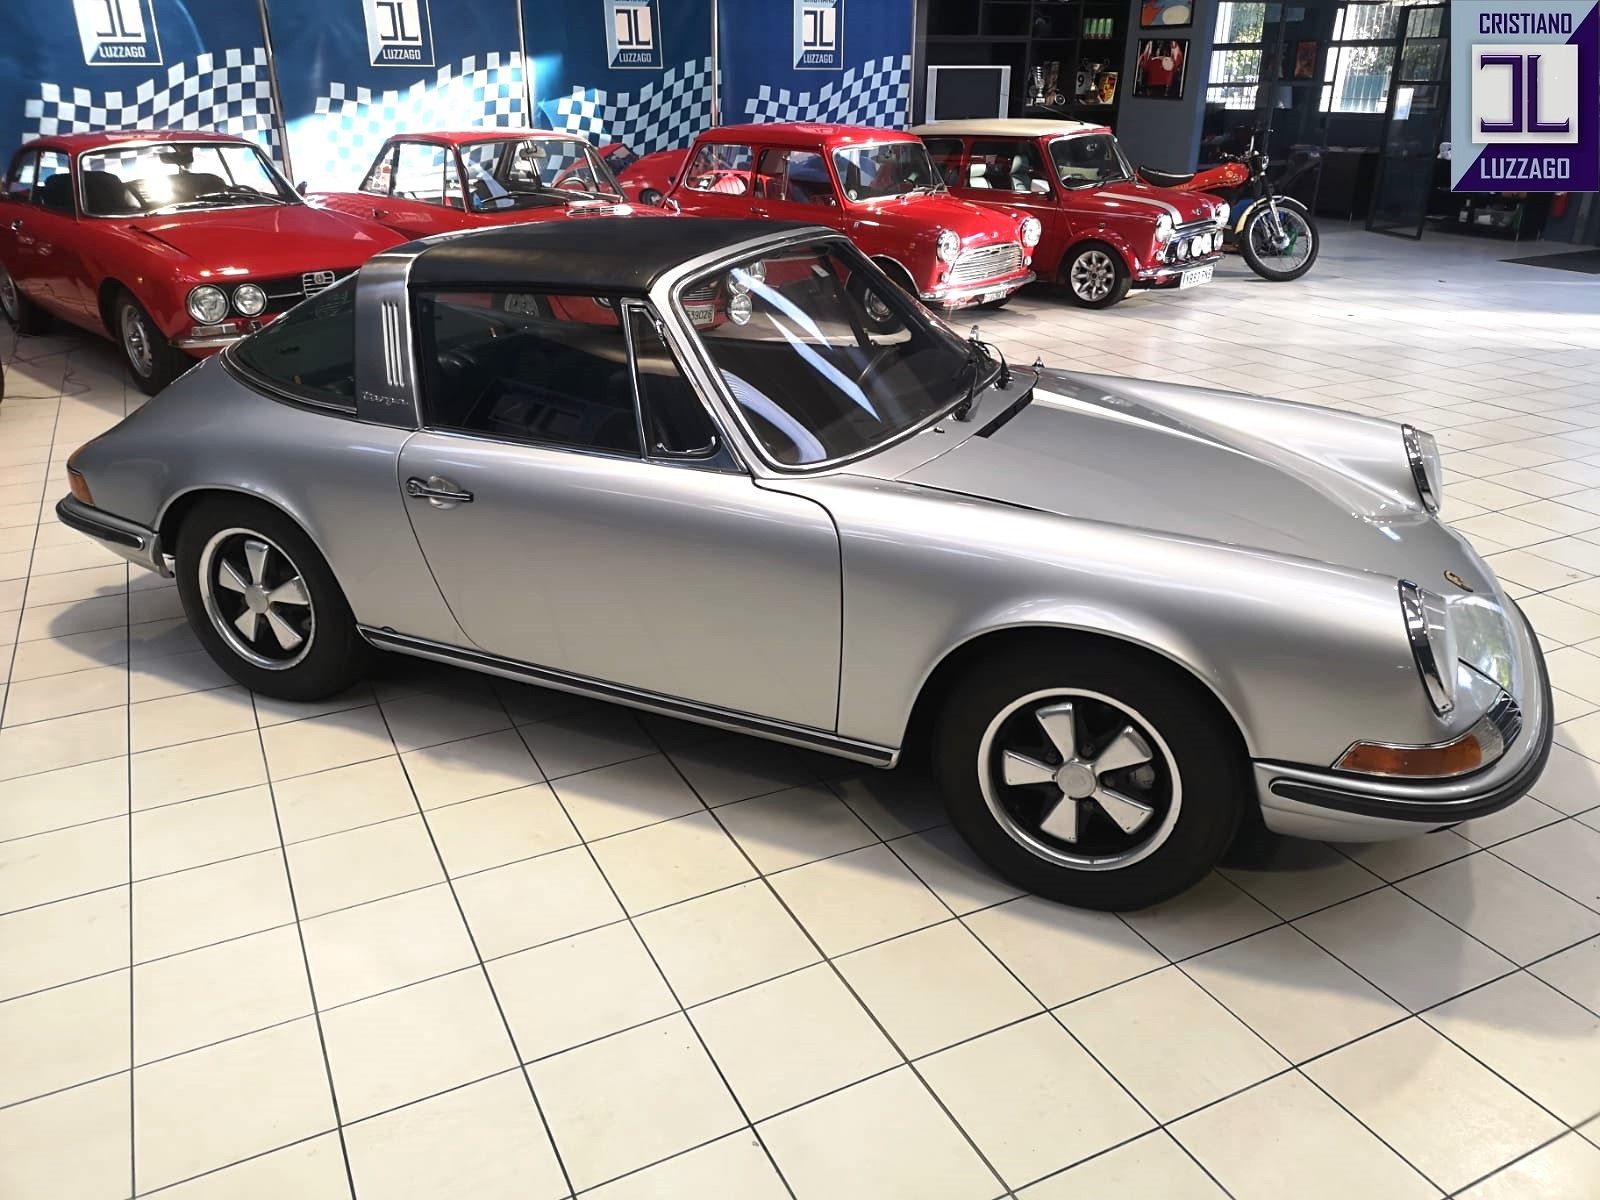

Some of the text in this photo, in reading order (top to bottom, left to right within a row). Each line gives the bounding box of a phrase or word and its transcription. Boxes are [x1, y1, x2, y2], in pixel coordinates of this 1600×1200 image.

[98, 46, 146, 58] LUZZAGO
[383, 49, 422, 60] LUZZAGO
[619, 52, 652, 63] LUZZAGO
[803, 53, 834, 64] LUZZAGO
